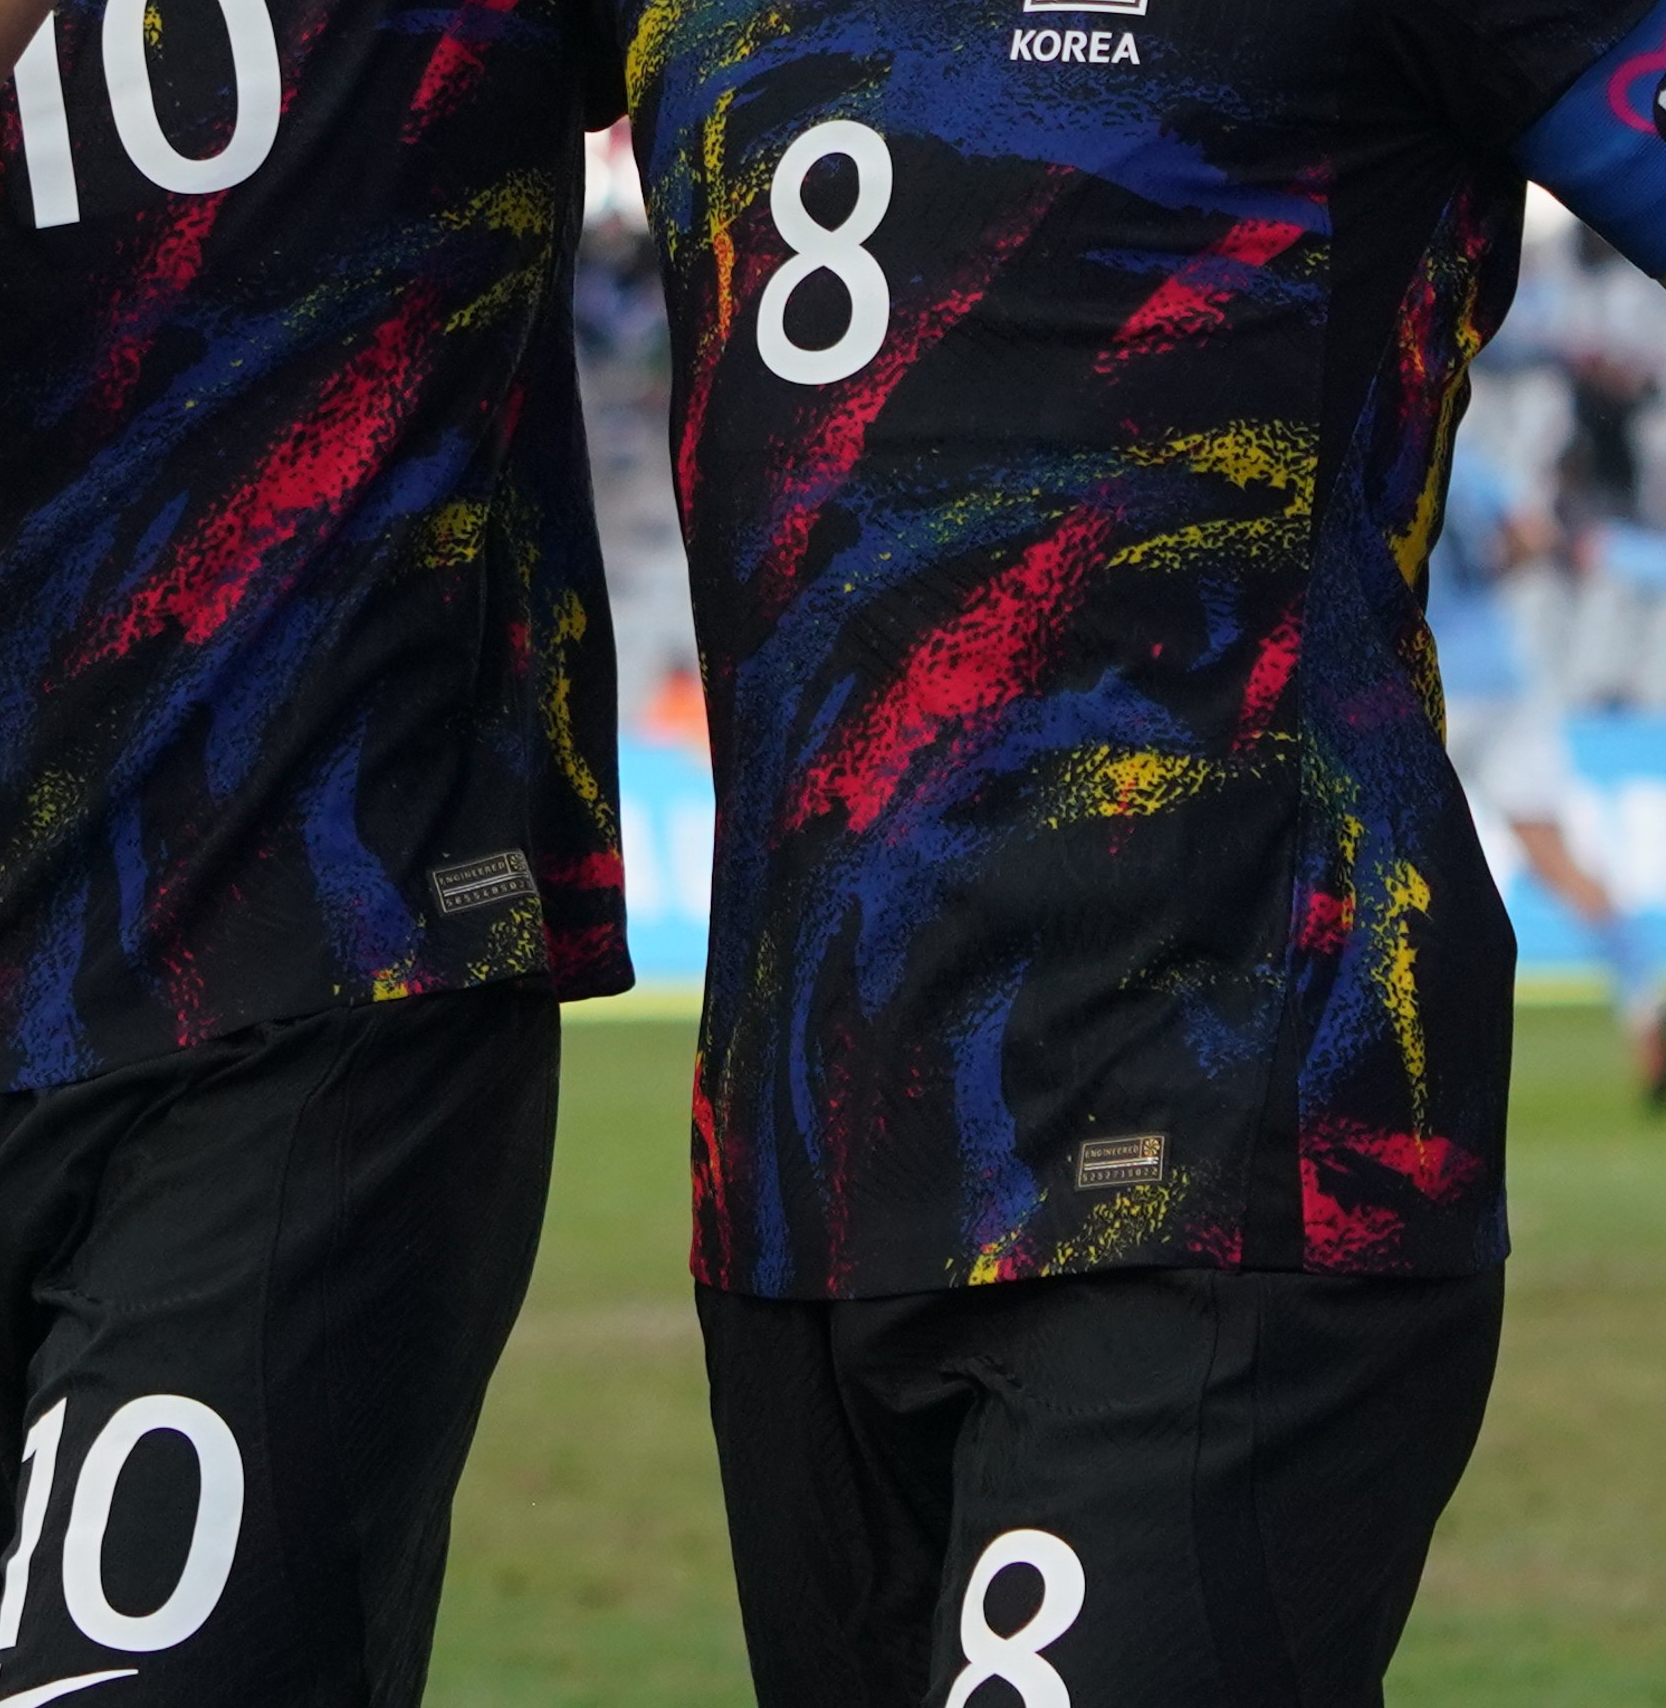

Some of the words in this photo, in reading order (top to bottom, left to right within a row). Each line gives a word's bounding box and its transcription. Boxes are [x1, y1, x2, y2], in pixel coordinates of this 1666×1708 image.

[1009, 29, 1140, 65] KOREA
[756, 119, 893, 385] 8
[944, 1527, 1086, 1708] 8
